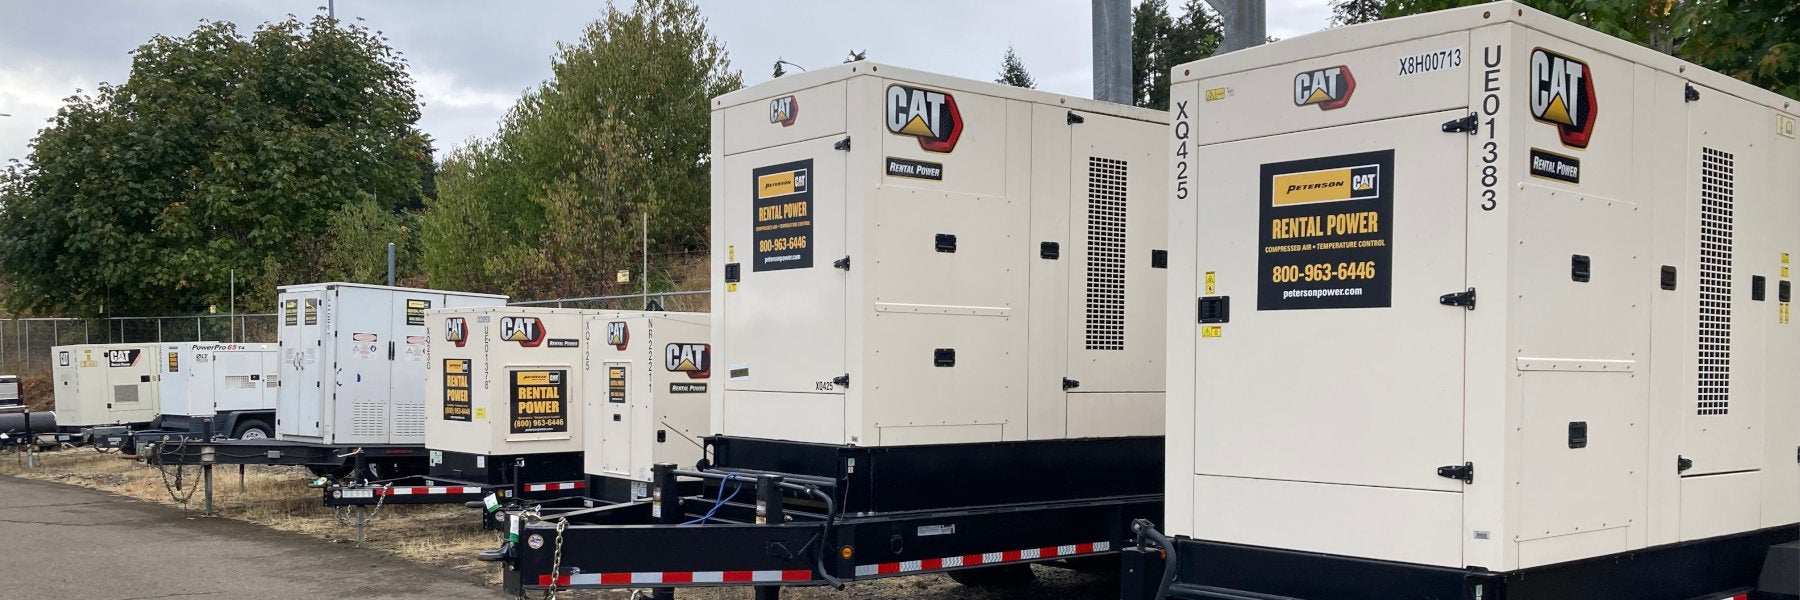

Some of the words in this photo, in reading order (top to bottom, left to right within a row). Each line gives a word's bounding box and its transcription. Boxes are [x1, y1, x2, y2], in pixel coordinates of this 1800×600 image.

[1399, 48, 1462, 76] X8H00713
[1295, 66, 1341, 105] CAT
[1531, 50, 1583, 127] CAT
[771, 97, 791, 124] CAT
[888, 86, 945, 138] CAT
[1480, 44, 1502, 212] UE01383
[1175, 100, 1189, 200] XQ425
[890, 162, 914, 174] RENTAL
[916, 164, 940, 178] POWER
[1533, 156, 1556, 173] RENTAL
[1557, 161, 1578, 178] POWER
[765, 180, 791, 189] PETERSON
[794, 175, 805, 188] CAT
[1286, 180, 1344, 194] PETERSON
[1352, 173, 1376, 191] CAT
[759, 204, 782, 222] RENTAL
[784, 201, 807, 219] POWER
[1272, 215, 1324, 240] RENTAL
[1327, 211, 1379, 235] POWER
[760, 235, 806, 252] 800-963-6446
[1265, 245, 1301, 254] COMPRESSED
[1316, 241, 1358, 250] TEMPERATURE
[1358, 239, 1386, 248] CONTROL
[1272, 261, 1375, 283] 800-963-6446
[1282, 286, 1362, 300] petersonpower.com
[446, 318, 463, 340] CAT
[501, 317, 536, 341] CAT
[608, 322, 624, 344] CAT
[110, 350, 131, 362] CAT
[666, 344, 706, 371] CAT
[446, 375, 468, 387] RENTAL
[816, 381, 833, 391] XQ425
[446, 390, 468, 402] POWER
[518, 387, 560, 400] RENTAL
[518, 401, 560, 414] POWER
[514, 420, 532, 428] (800)
[533, 418, 564, 427] 963-6446
